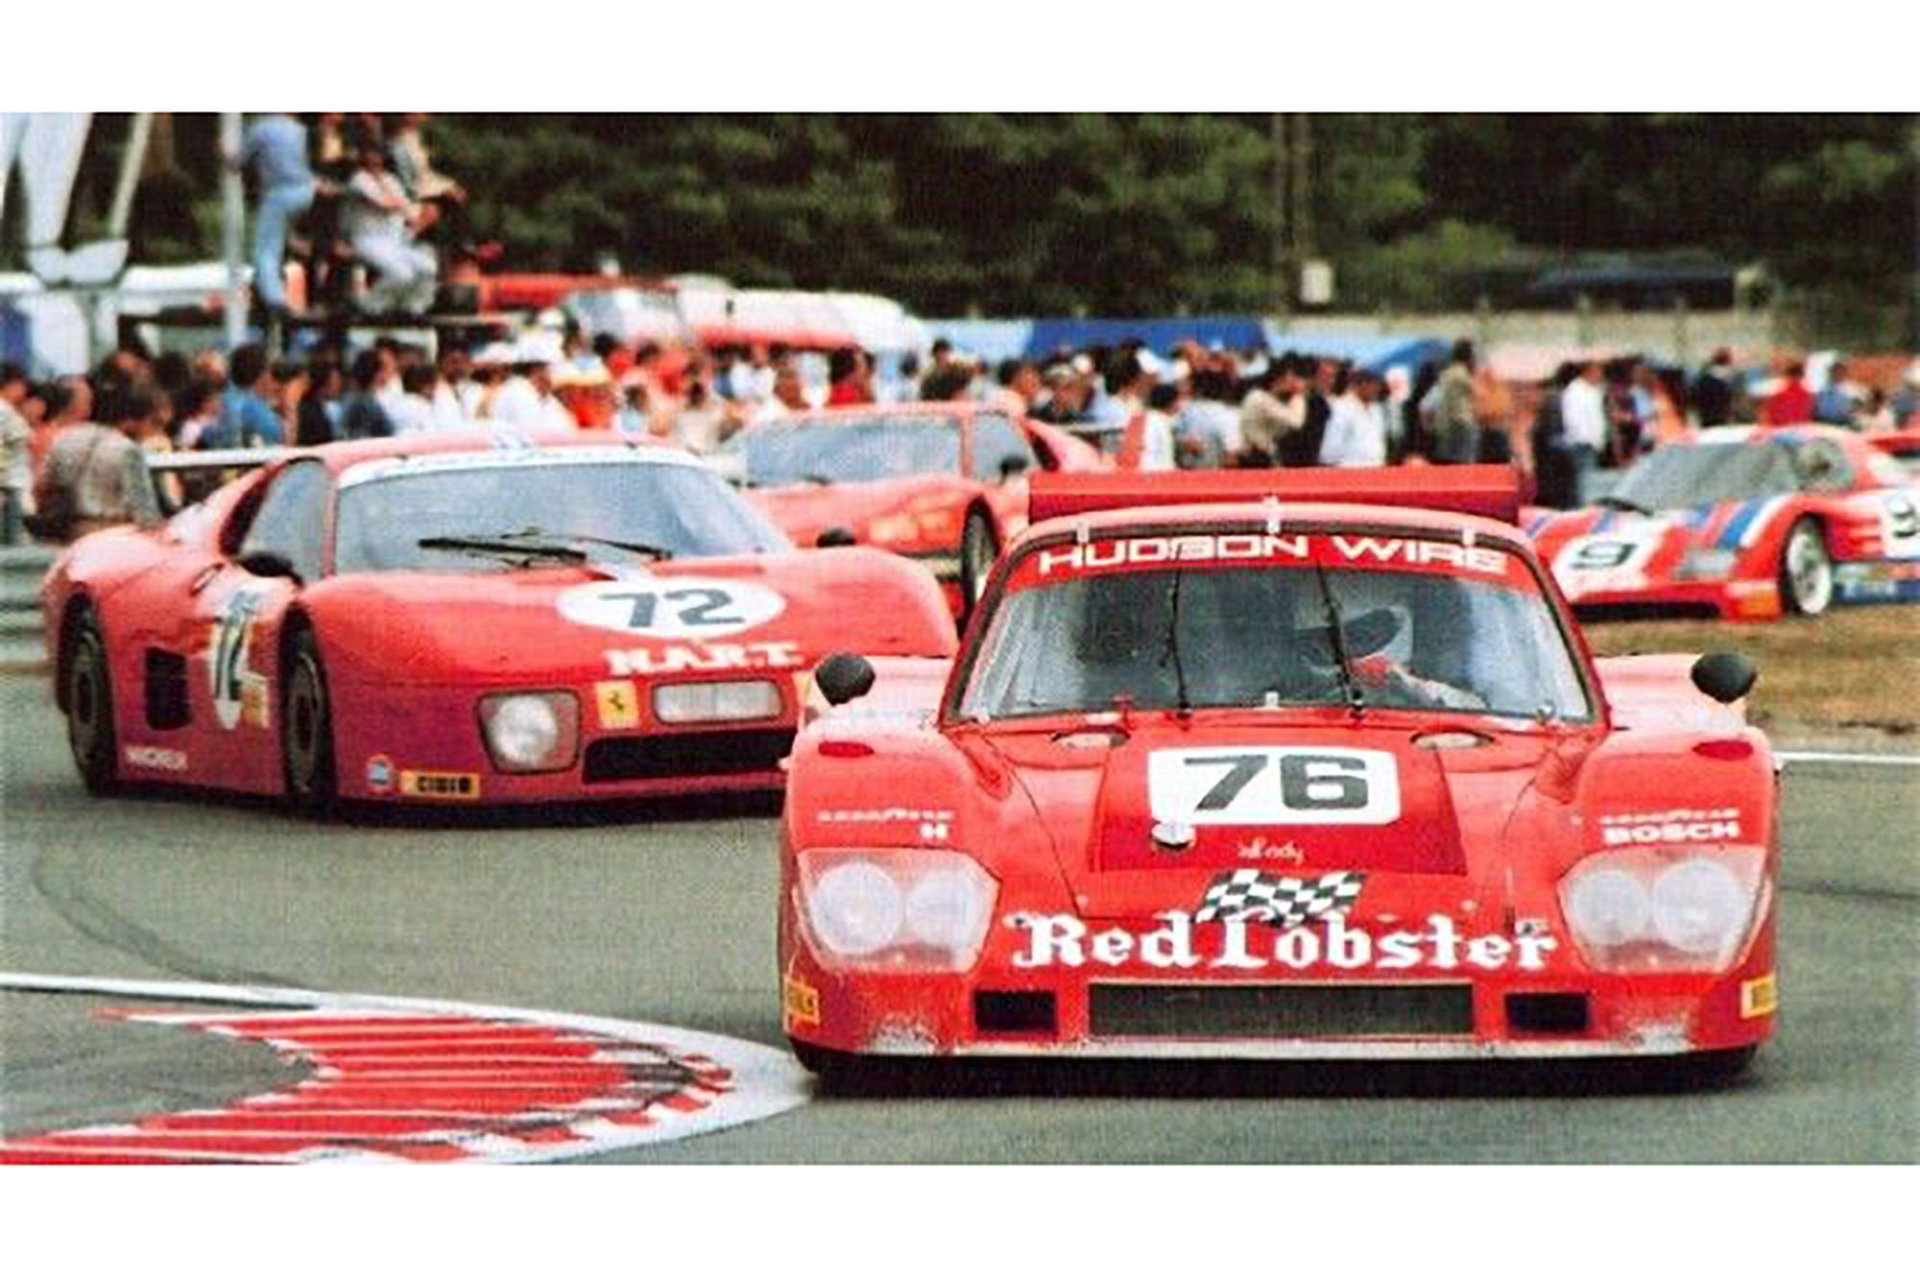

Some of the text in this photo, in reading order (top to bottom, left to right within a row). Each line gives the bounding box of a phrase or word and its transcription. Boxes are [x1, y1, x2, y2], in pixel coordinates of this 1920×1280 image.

[1038, 534, 1507, 575] HUDSON WIRE
[1568, 541, 1638, 571] 9
[598, 587, 745, 628] 72
[1183, 753, 1369, 812] 76
[1603, 821, 1741, 845] BOSCH
[1002, 908, 1203, 967] Red
